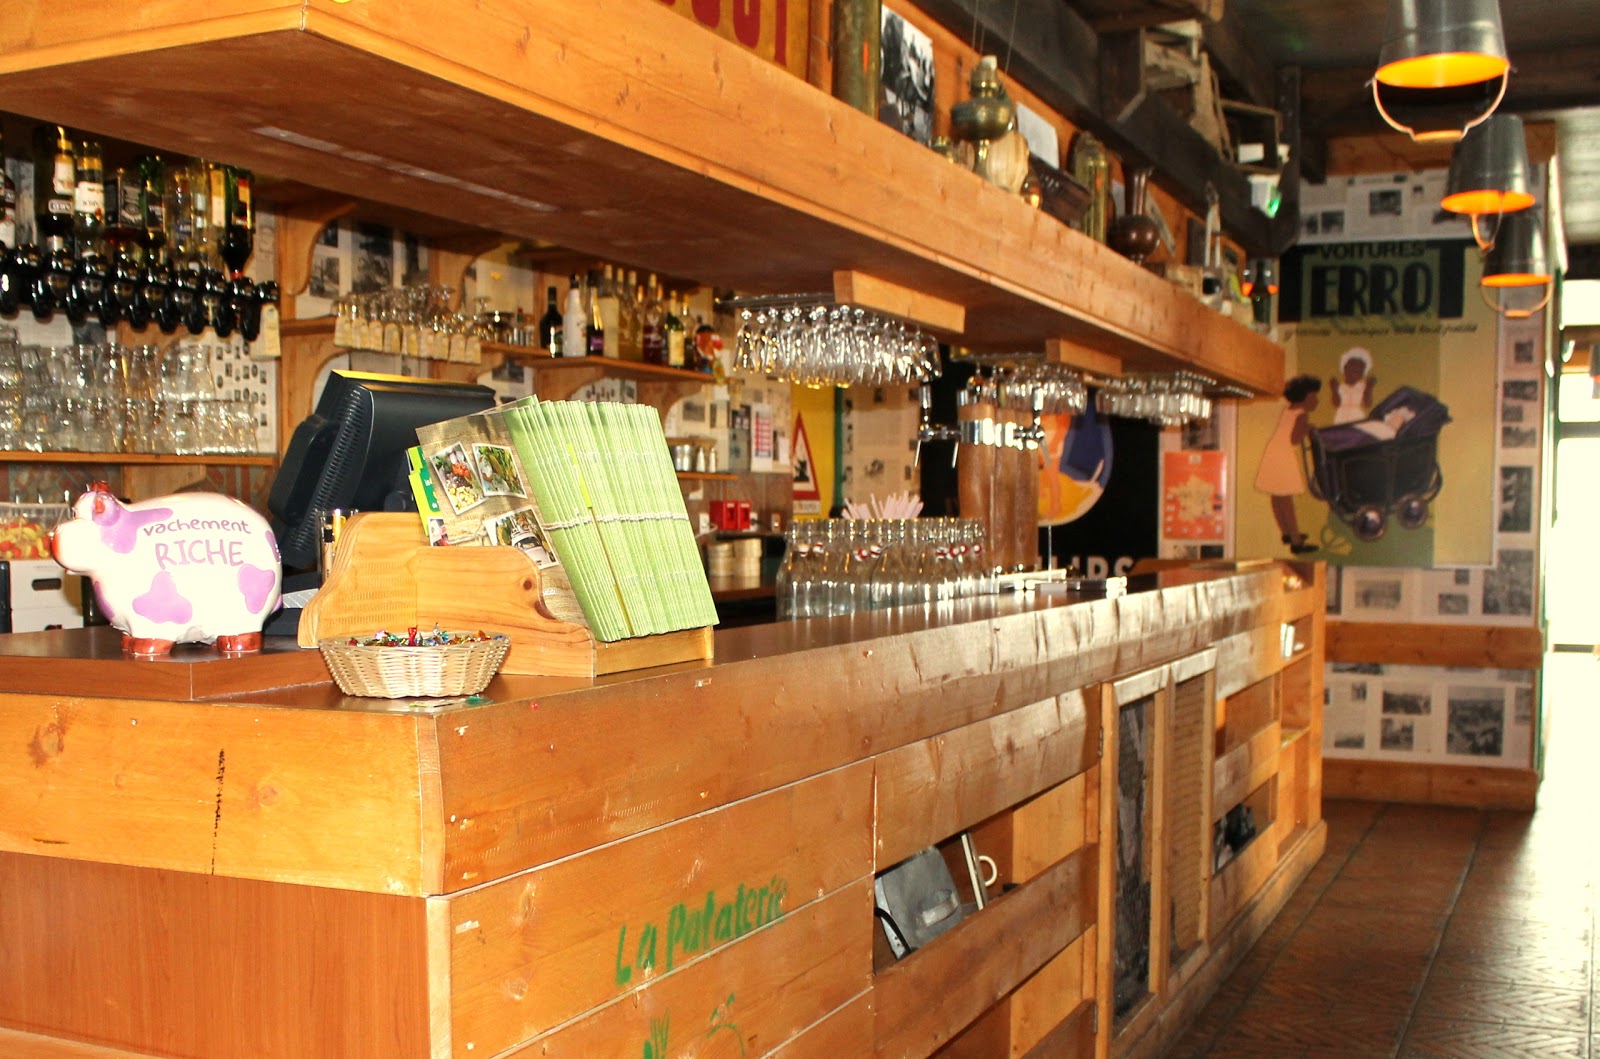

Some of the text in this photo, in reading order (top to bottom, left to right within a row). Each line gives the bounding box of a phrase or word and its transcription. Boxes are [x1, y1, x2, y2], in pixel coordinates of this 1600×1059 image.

[1319, 241, 1426, 259] VOITURES
[143, 519, 252, 536] vachement
[155, 539, 244, 570] RICHE
